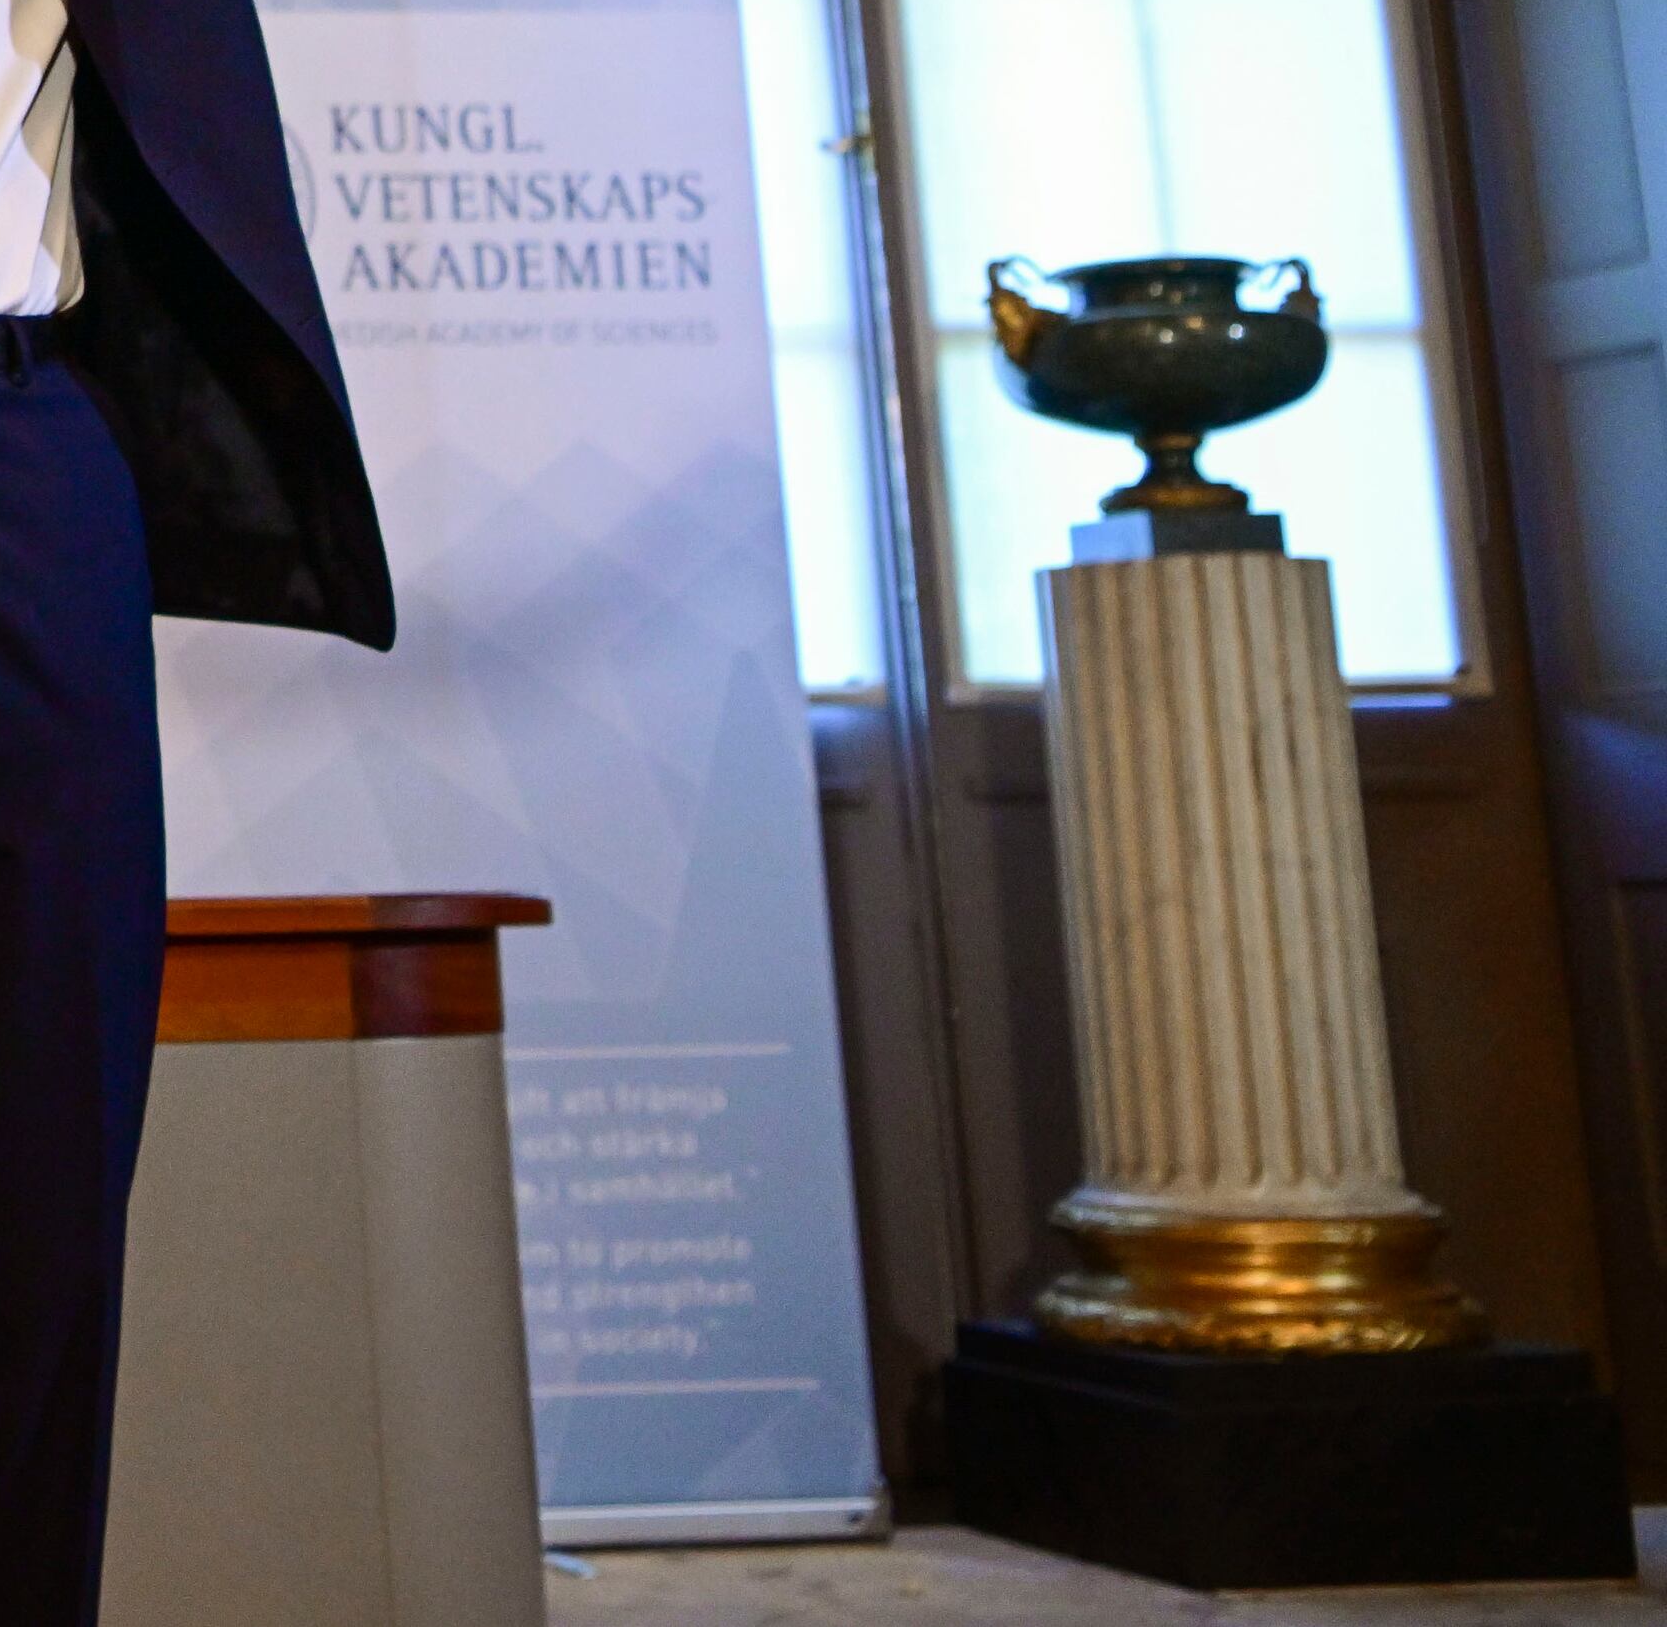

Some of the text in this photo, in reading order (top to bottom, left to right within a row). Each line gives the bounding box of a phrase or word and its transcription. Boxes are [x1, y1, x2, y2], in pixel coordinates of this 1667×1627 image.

[330, 102, 545, 155] KUNGL.
[341, 239, 713, 293] AKADEMIEN
[426, 319, 543, 346] ACADEMY
[592, 317, 719, 346] SCIENCES
